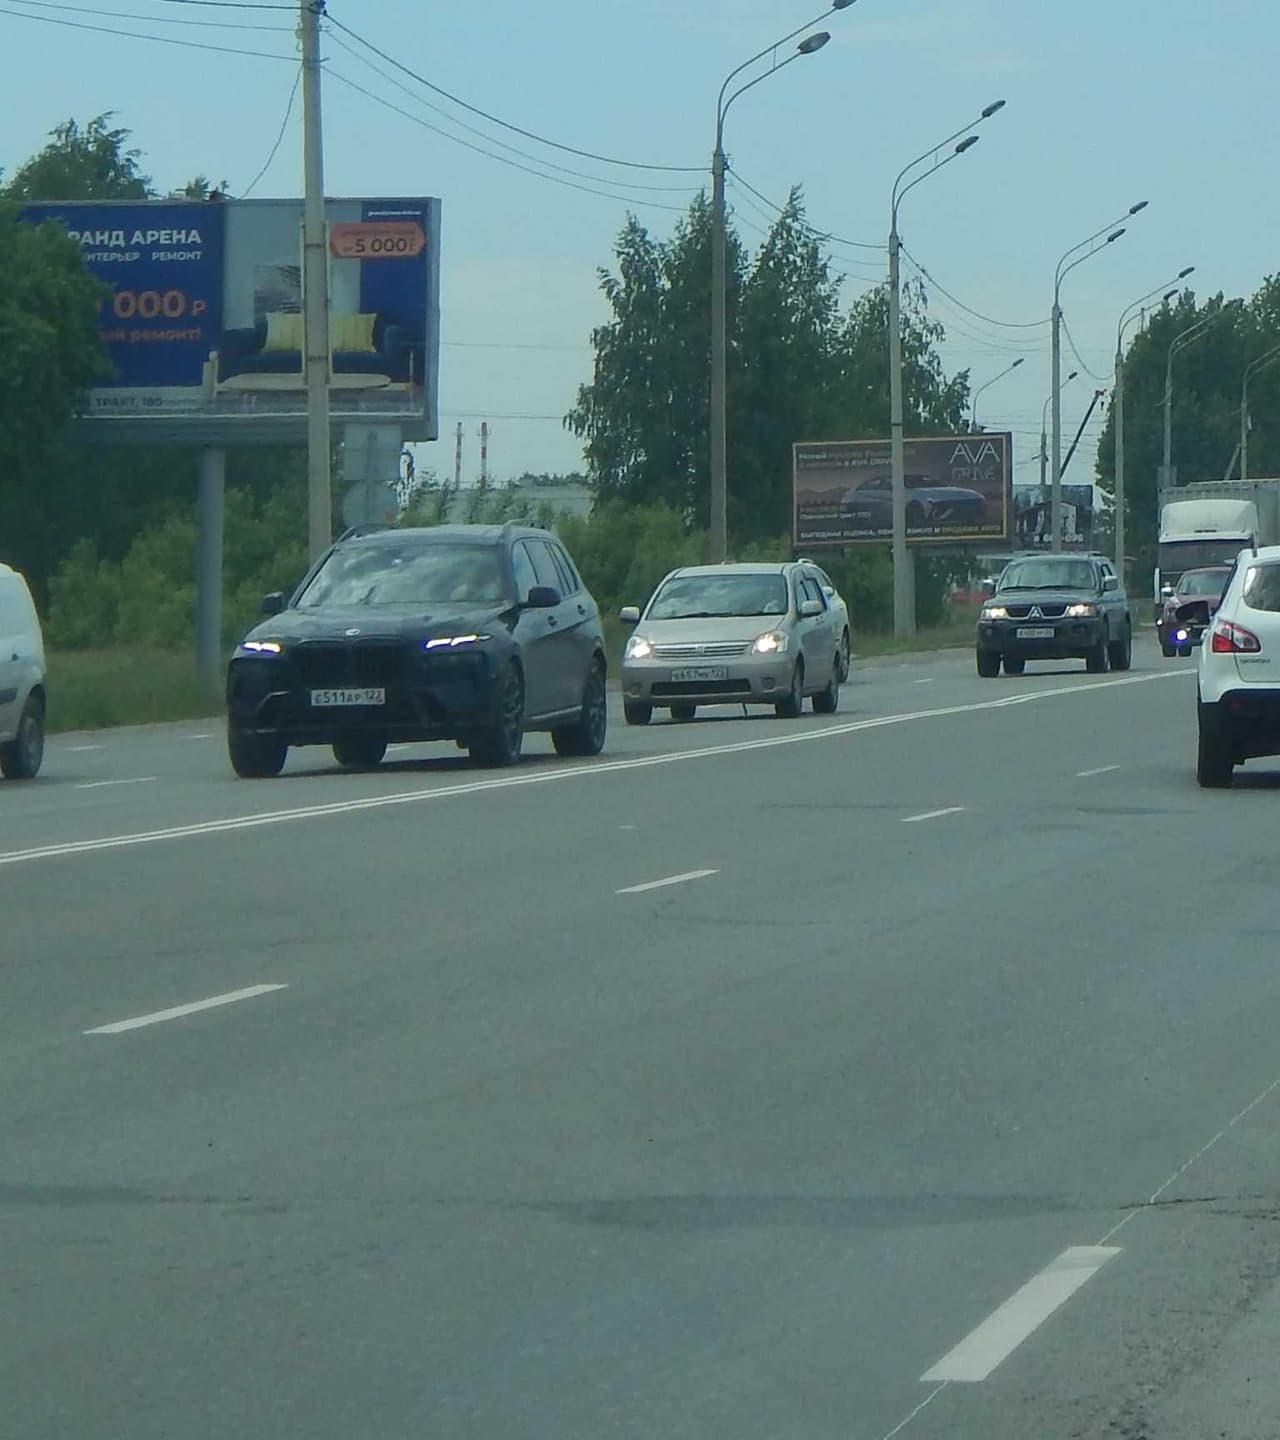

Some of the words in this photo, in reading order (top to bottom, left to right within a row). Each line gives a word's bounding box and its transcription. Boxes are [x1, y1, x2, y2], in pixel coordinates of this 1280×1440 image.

[68, 230, 125, 248] РАНД
[130, 229, 202, 245] АРЕНА
[87, 251, 141, 262] НТЕРЬЕР
[151, 250, 203, 261] РЕМОНТ
[949, 441, 1001, 465] AVA
